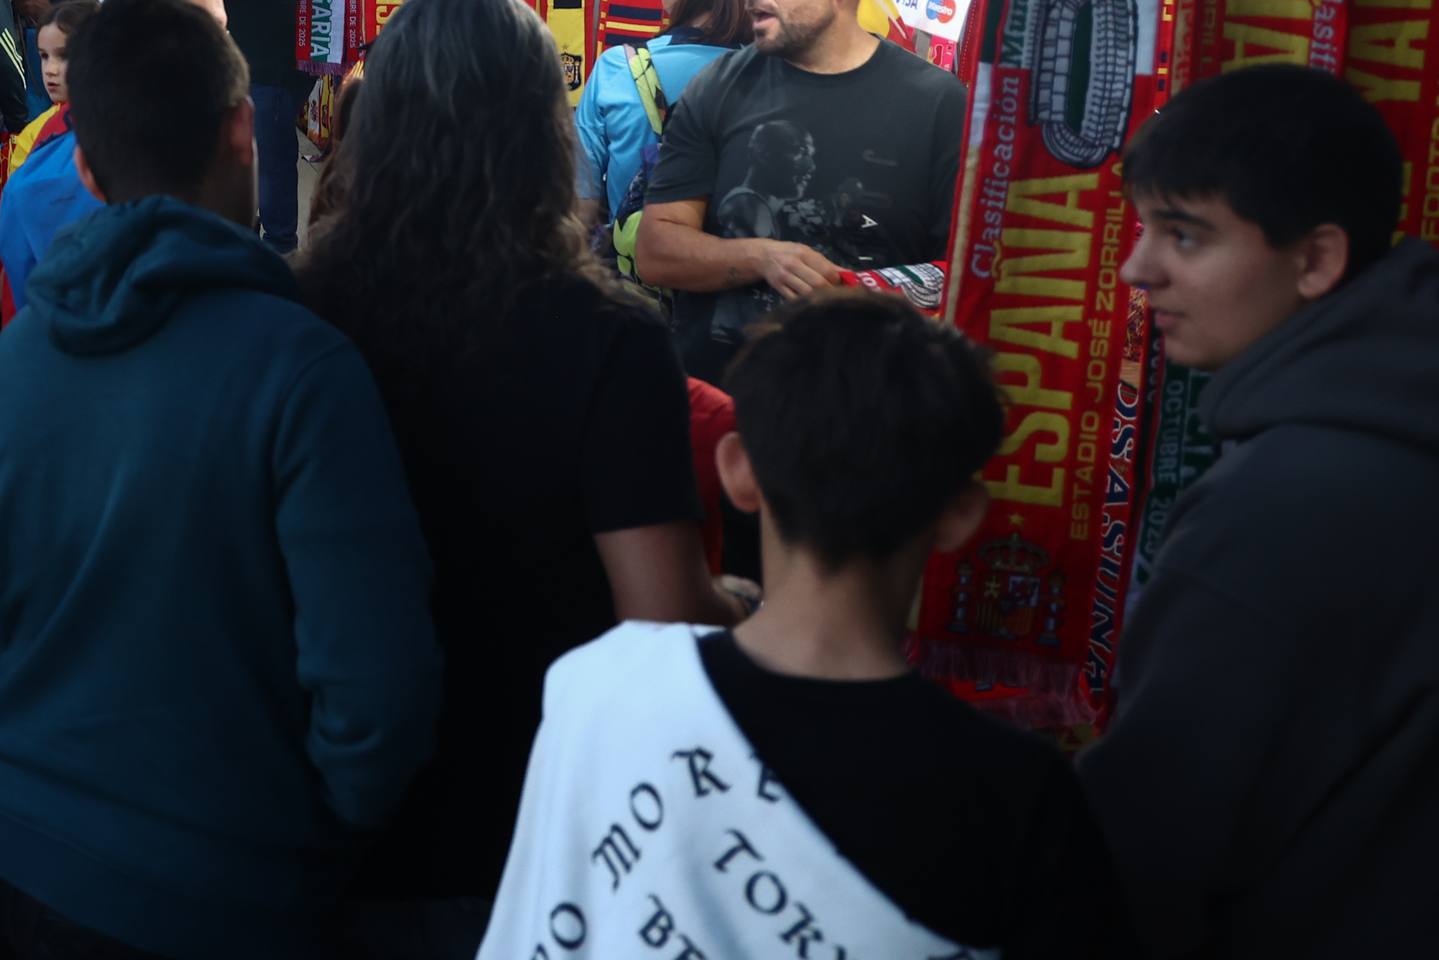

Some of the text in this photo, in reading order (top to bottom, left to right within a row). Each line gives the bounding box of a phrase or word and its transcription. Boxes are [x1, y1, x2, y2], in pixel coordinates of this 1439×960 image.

[970, 75, 1020, 278] Clasificación
[973, 172, 1099, 508] ESPAÑA
[1071, 162, 1125, 540] ESTADIO JOSÉ ZORRILLA
[1158, 379, 1185, 484] OCTUBRE
[591, 746, 782, 892] MORE
